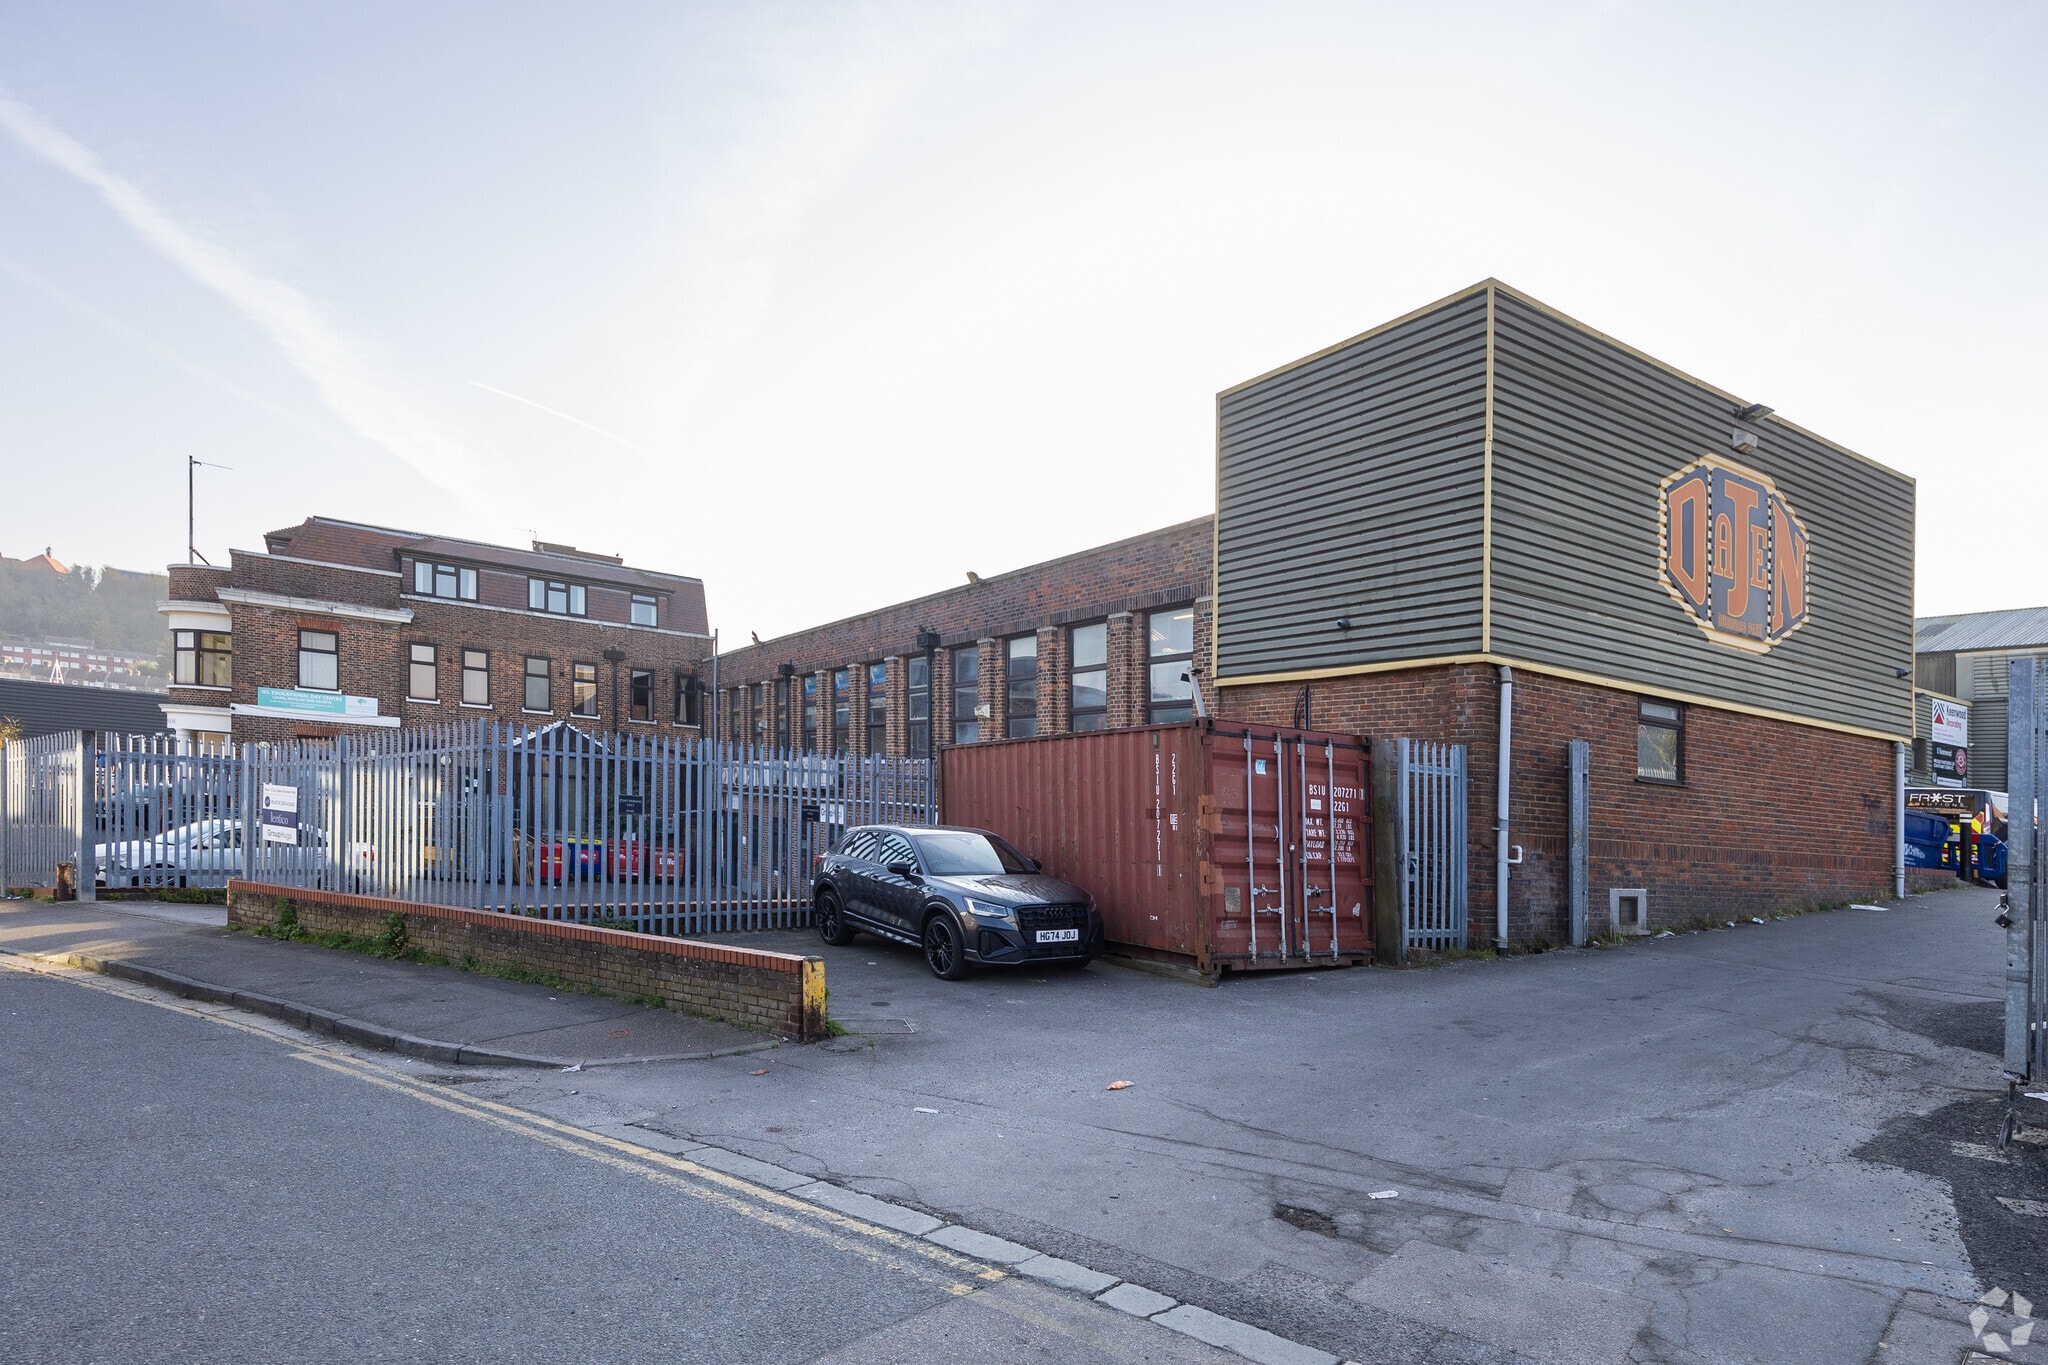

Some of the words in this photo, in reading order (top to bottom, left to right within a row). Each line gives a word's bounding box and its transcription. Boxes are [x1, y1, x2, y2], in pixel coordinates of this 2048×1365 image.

[1669, 478, 1804, 634] DAJEN
[1334, 787, 1357, 799] 207271
[1334, 801, 1349, 813] 22G1
[1040, 931, 1060, 941] HG74
[1061, 930, 1076, 940] JOJ
